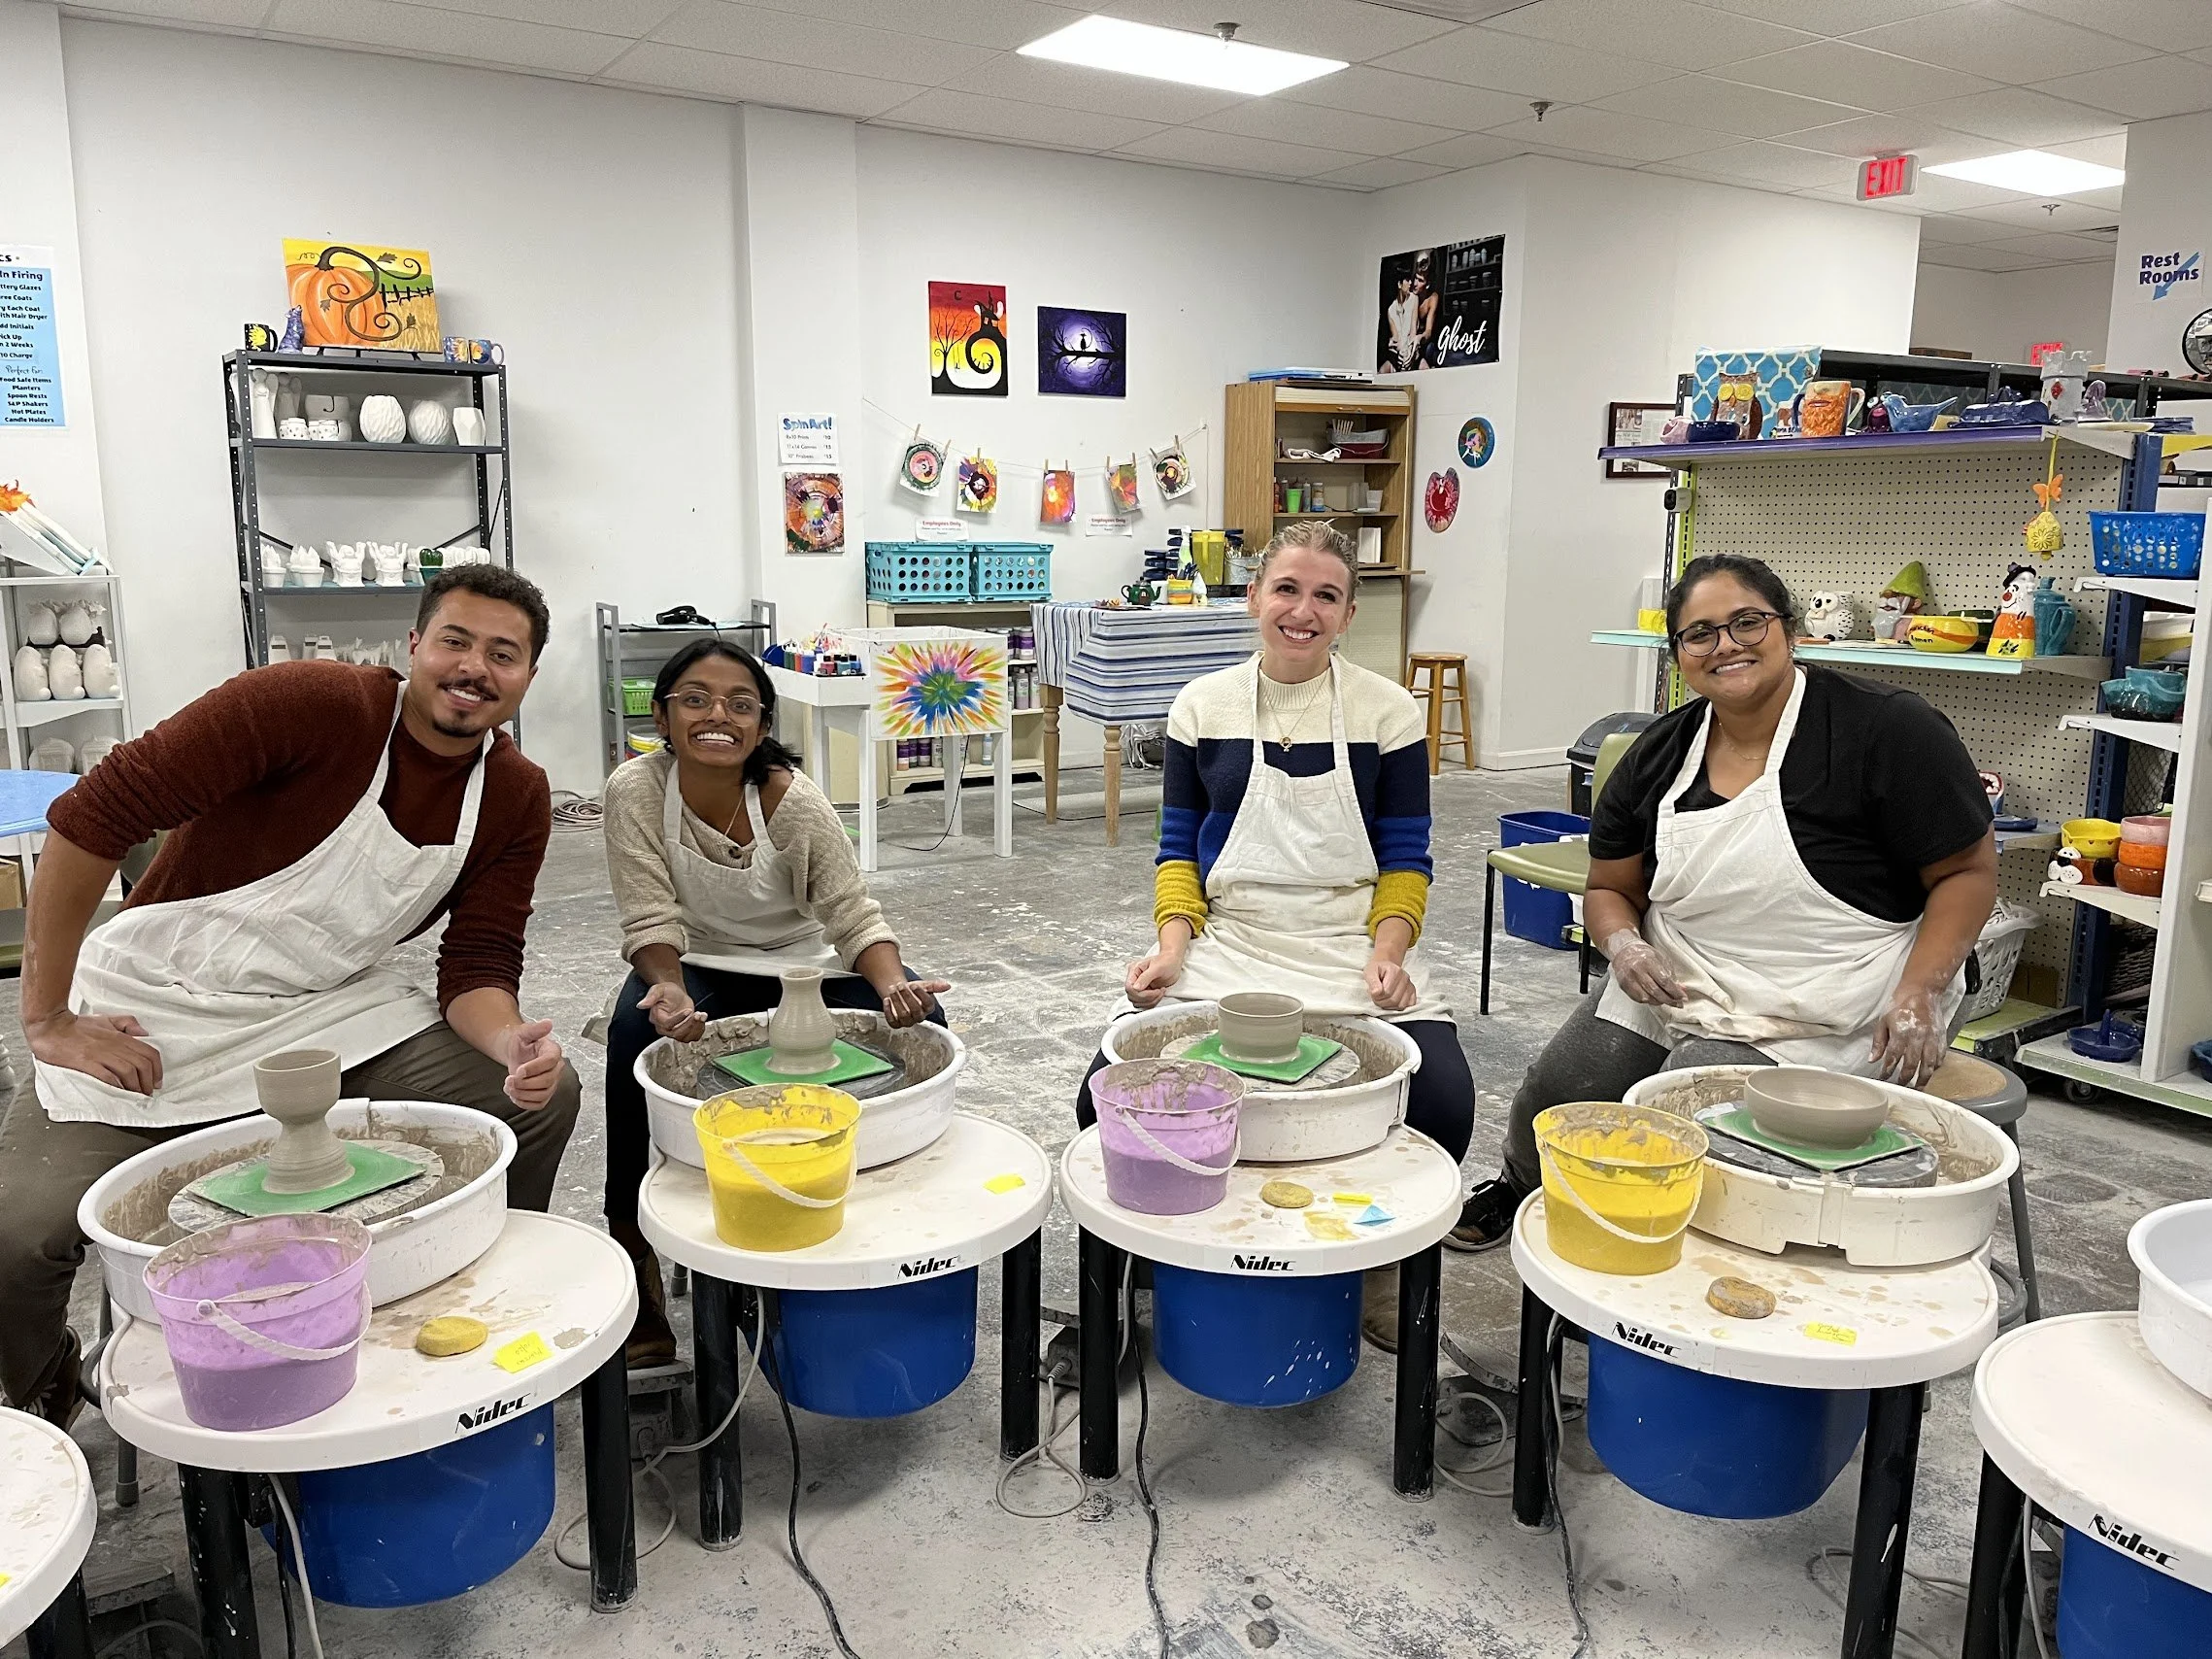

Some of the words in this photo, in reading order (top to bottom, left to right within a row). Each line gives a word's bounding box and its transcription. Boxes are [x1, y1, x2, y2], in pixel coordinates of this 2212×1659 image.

[1865, 156, 1907, 198] EXIT
[2141, 252, 2180, 269] Rest
[12, 270, 44, 282] Firing
[2139, 268, 2199, 286] Rooms
[5, 364, 30, 376] Perfect
[809, 417, 832, 430] Art!
[897, 1254, 960, 1279] Nidec
[1230, 1254, 1296, 1271] Nidec
[1612, 1321, 1682, 1359] Nidec
[455, 1392, 531, 1434] Nidec
[2088, 1513, 2181, 1572] Nidec
